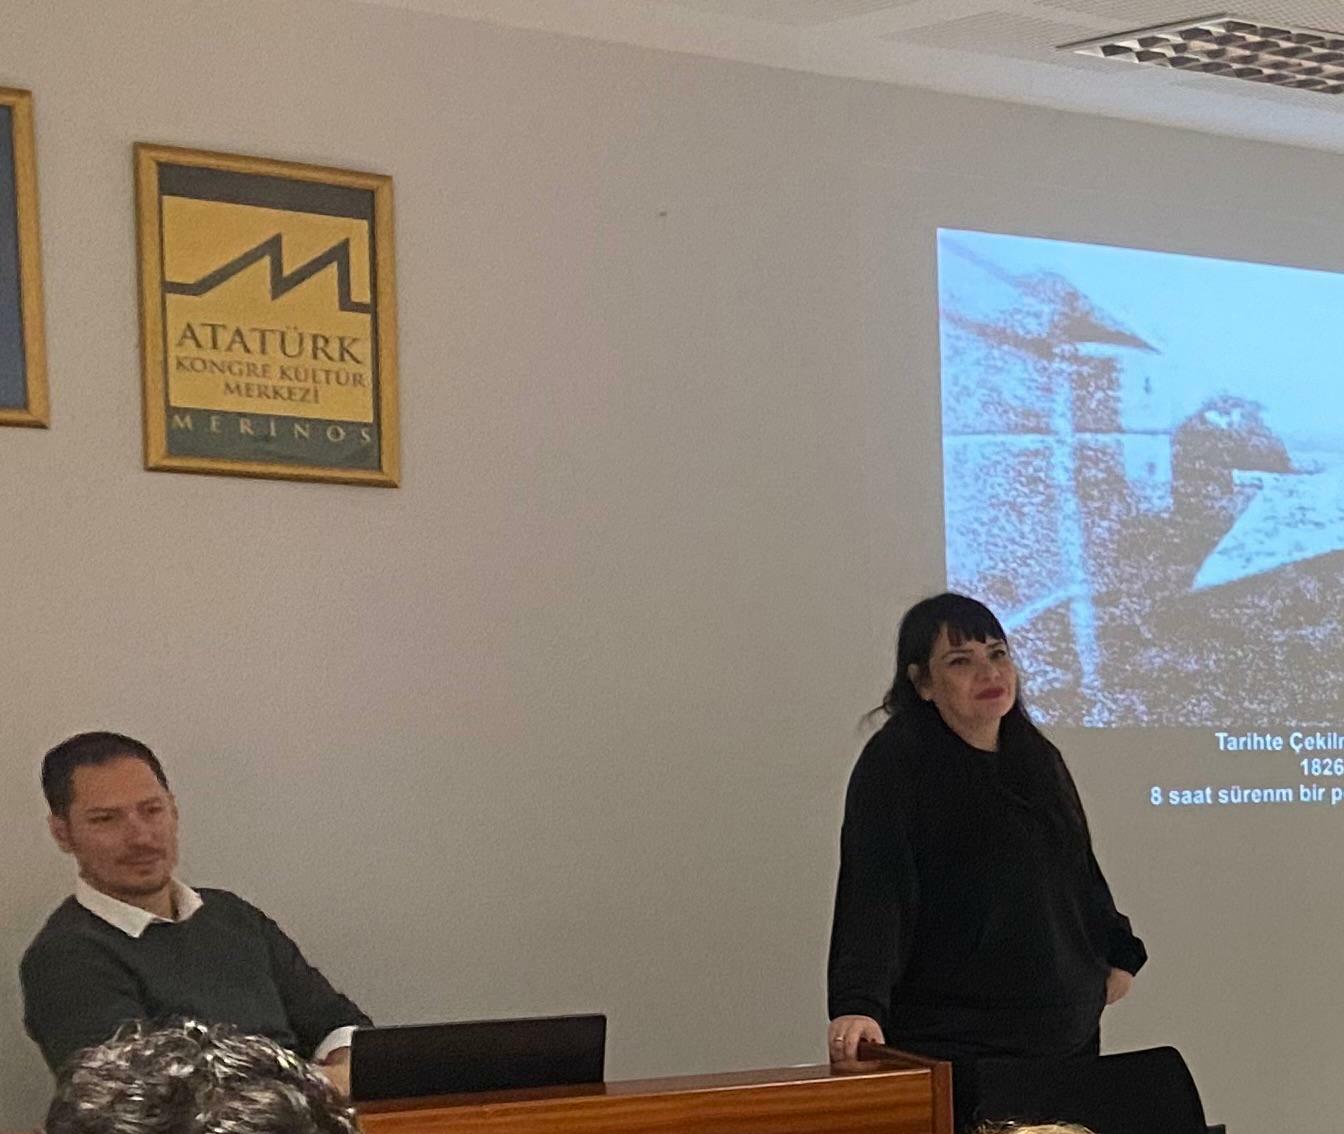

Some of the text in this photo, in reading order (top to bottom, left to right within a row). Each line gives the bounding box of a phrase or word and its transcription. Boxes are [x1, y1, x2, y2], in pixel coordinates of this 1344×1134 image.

[175, 322, 364, 365] ATATÜRK
[175, 355, 272, 380] KONGRE
[223, 381, 320, 405] MERKEZİ
[1215, 732, 1284, 751] Tarihte
[1300, 758, 1344, 776] 1826
[1150, 786, 1162, 805] 8
[1169, 787, 1212, 804] saat
[1218, 785, 1292, 804] sürenm
[1299, 784, 1325, 802] bir
